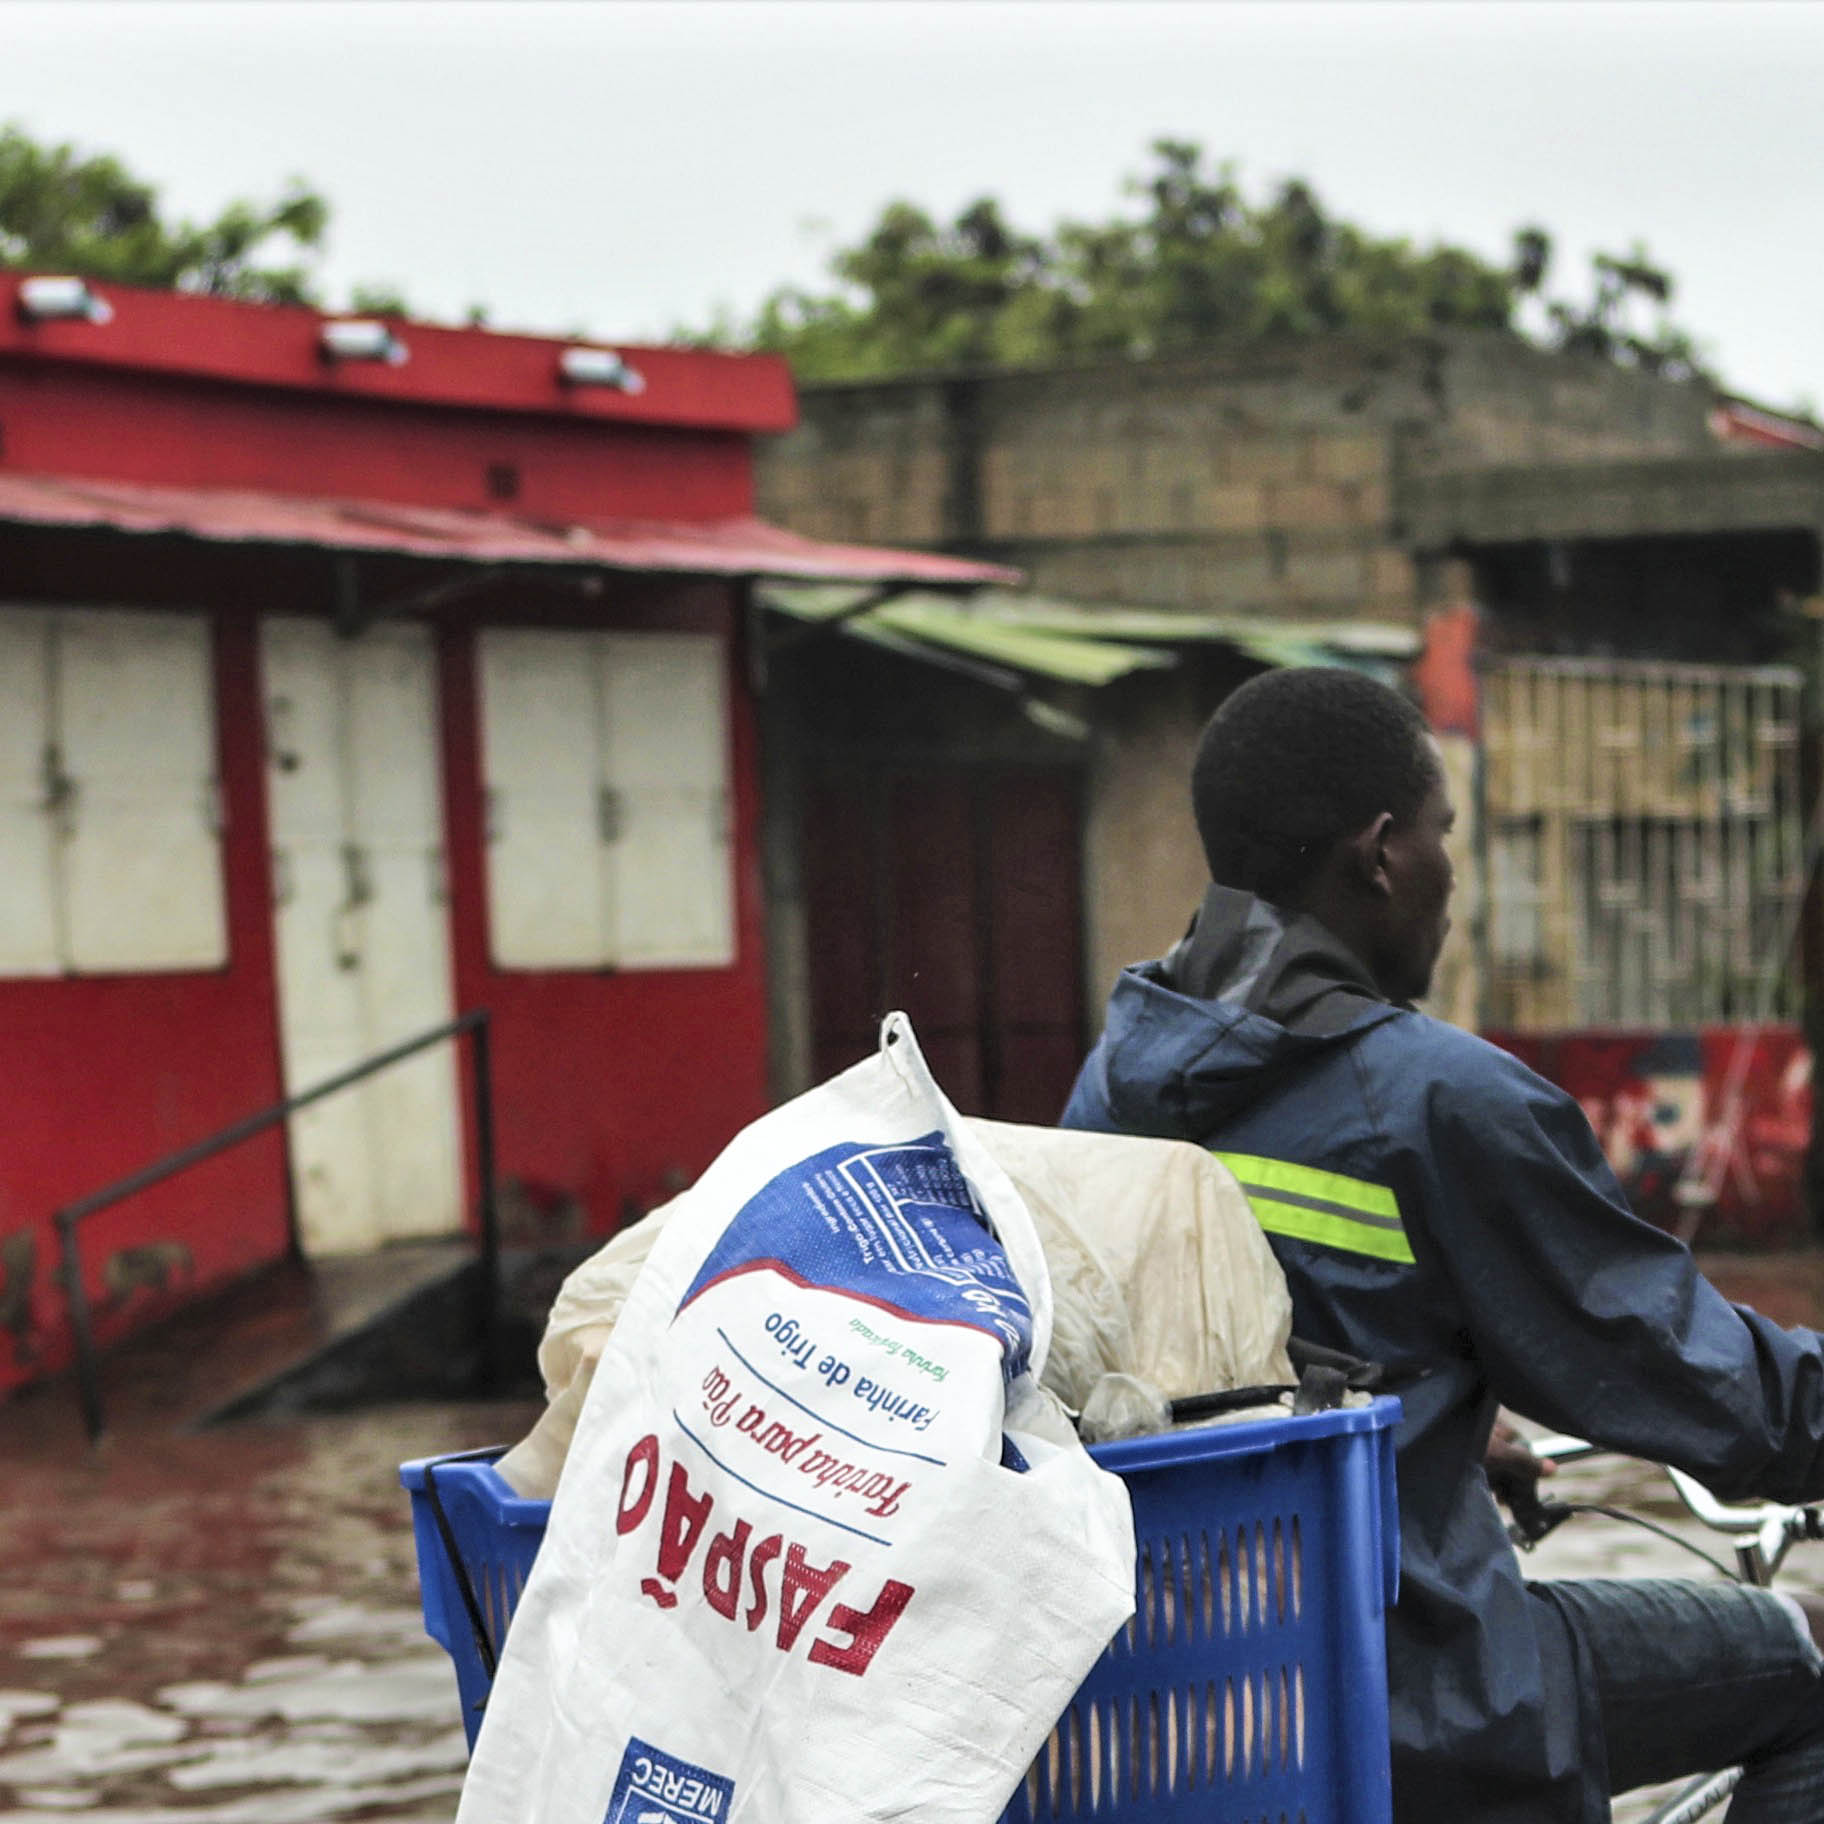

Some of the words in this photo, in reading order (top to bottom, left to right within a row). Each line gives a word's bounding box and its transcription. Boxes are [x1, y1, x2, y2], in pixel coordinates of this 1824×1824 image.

[764, 1312, 818, 1370] Trigo
[818, 1355, 851, 1387] de
[853, 1376, 941, 1431] Farinha
[735, 1405, 823, 1464] para
[797, 1449, 912, 1518] Farinha
[615, 1434, 916, 1677] FASPÃO
[631, 1757, 723, 1816] MEREC
